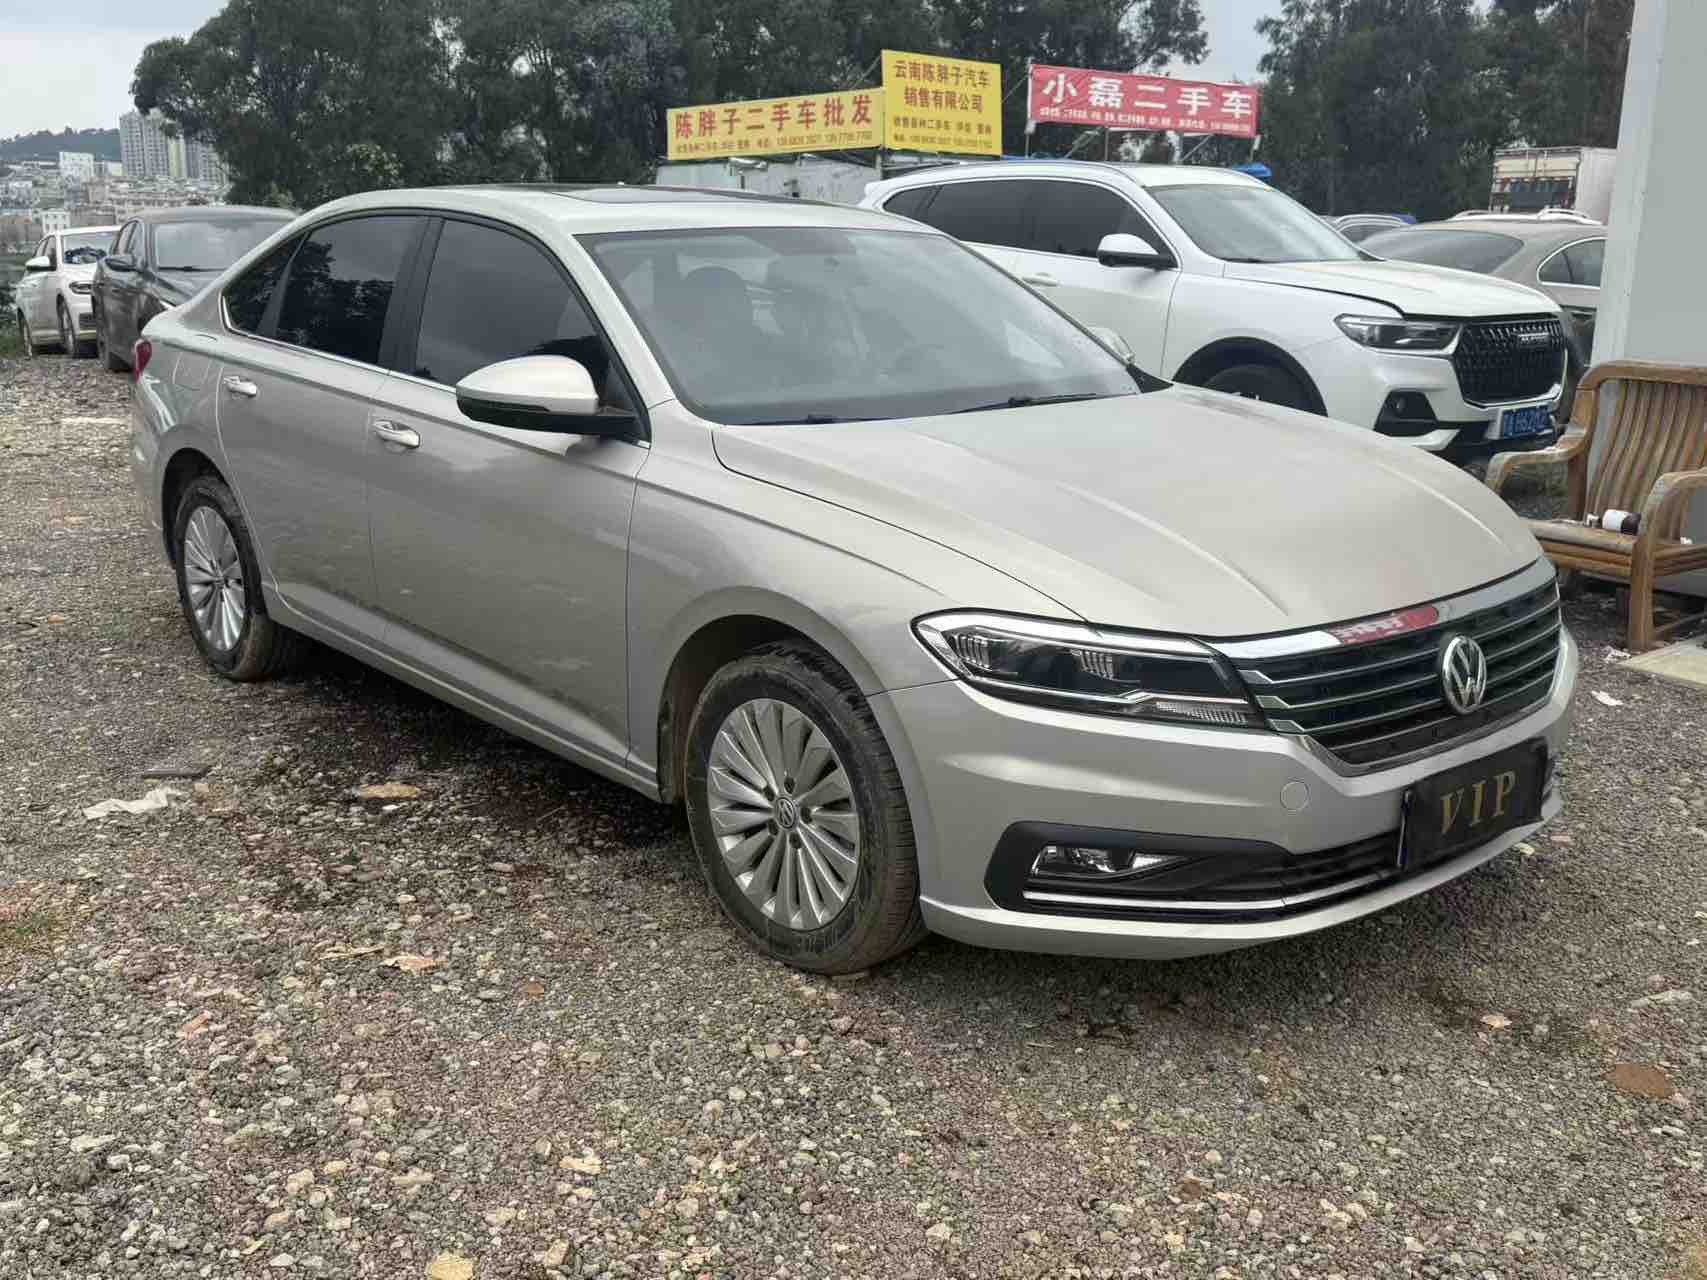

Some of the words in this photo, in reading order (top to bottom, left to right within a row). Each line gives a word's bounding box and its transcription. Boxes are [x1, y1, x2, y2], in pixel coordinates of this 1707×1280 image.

[675, 95, 873, 140] 陈胖子二手车批发
[904, 85, 983, 113] 销售有限公司
[1041, 73, 1253, 119] 小磊二手车
[1440, 770, 1517, 836] VIP
